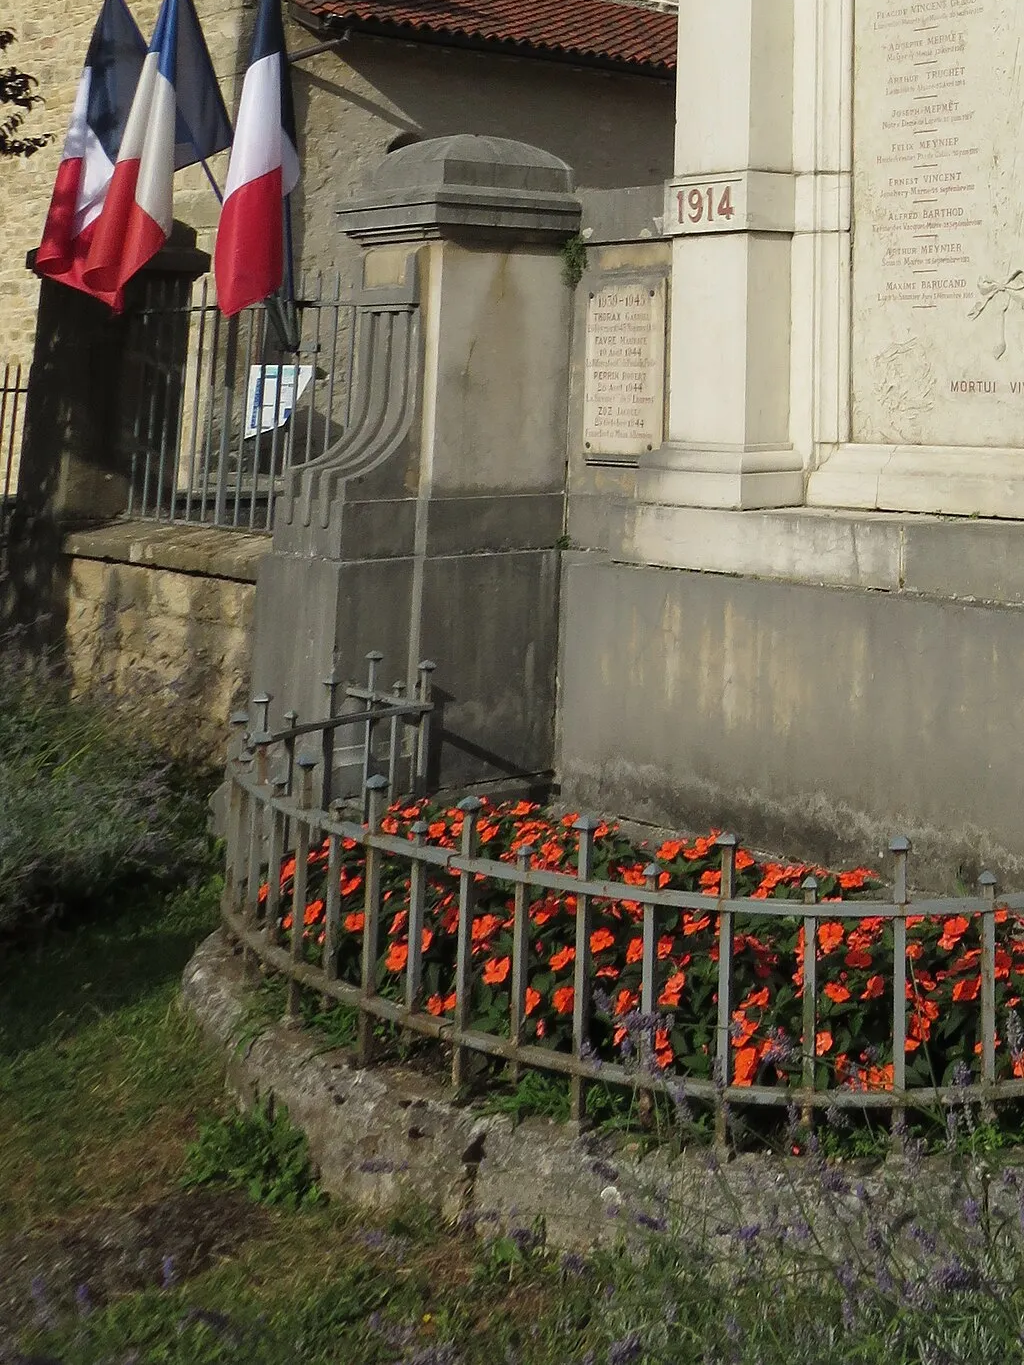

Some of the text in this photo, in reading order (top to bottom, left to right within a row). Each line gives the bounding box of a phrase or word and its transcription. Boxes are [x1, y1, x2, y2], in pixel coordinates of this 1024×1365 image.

[927, 67, 966, 79] TRUCHET
[892, 108, 920, 118] JOSEPH
[889, 172, 962, 186] ERNEST VINCENT
[677, 186, 735, 224] 1914
[888, 207, 964, 221] ALFRED BARTHOD
[921, 243, 962, 254] MEYNIER
[886, 279, 967, 290] MAXIME BARUCAND
[598, 294, 645, 307] 1939-1945
[594, 313, 620, 322] THORAX
[950, 380, 996, 393] MORTUI
[598, 407, 612, 415] ZOZ
